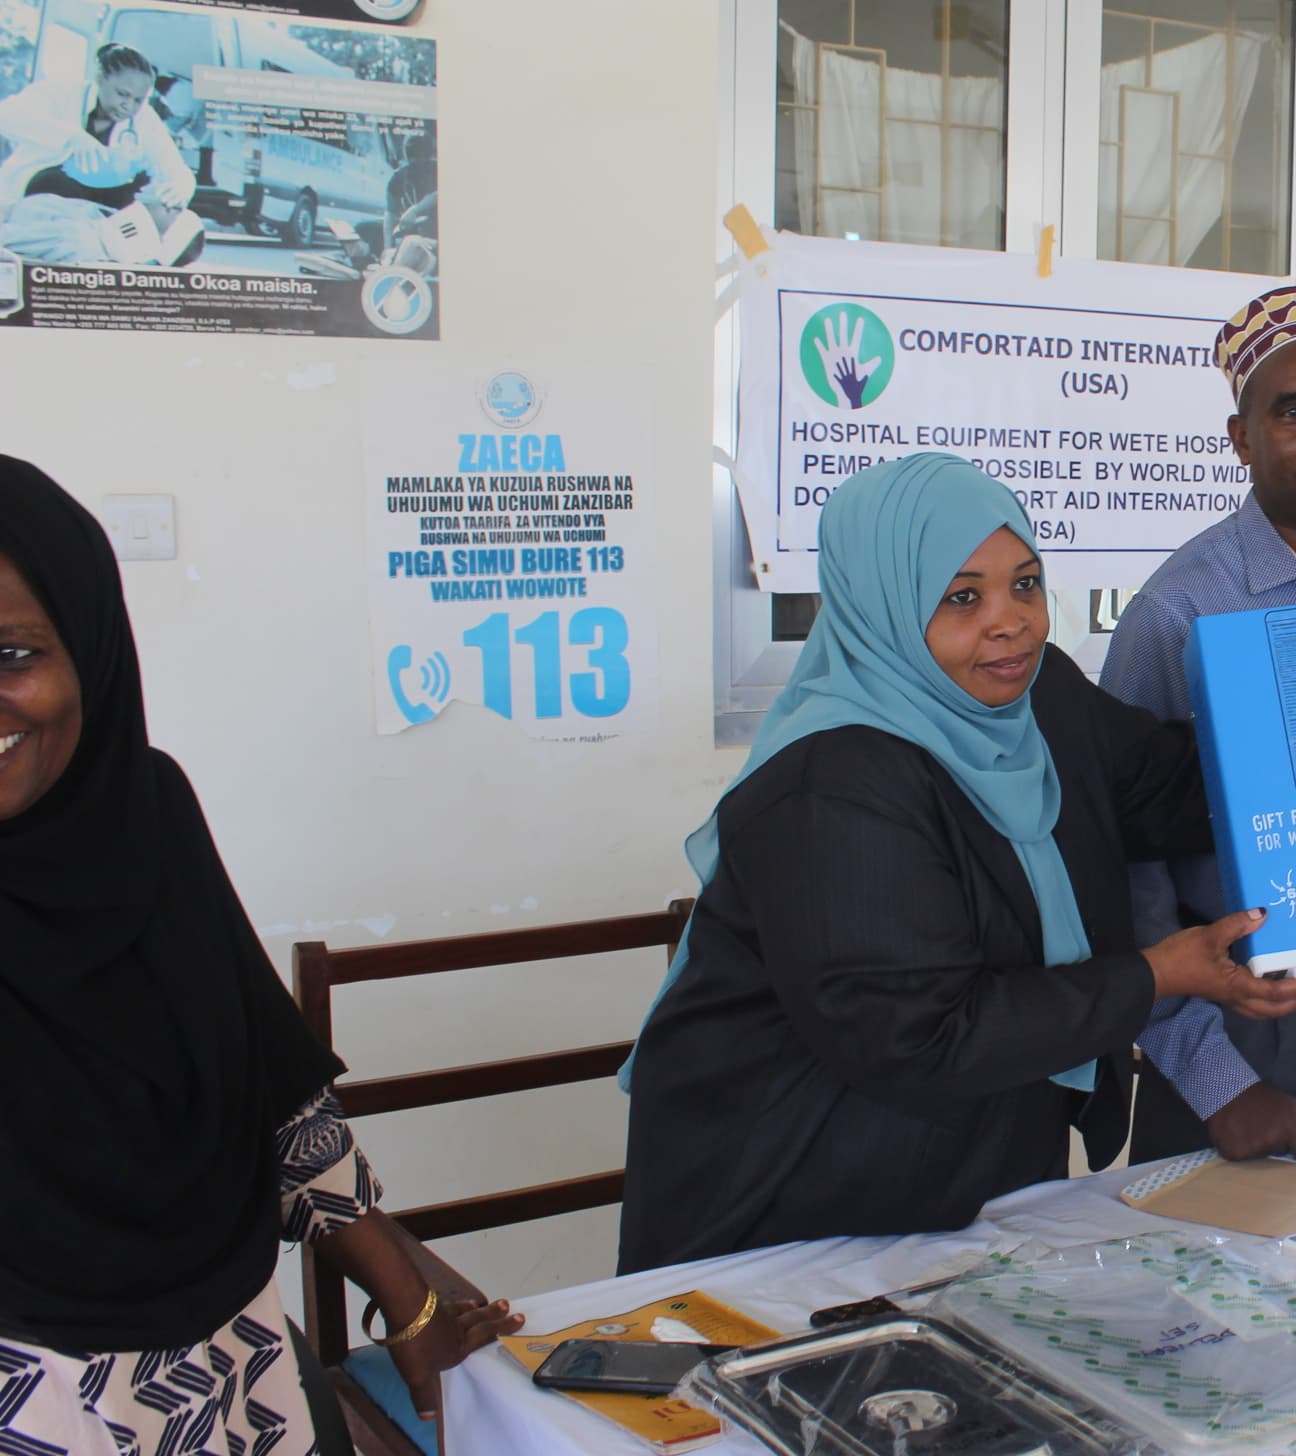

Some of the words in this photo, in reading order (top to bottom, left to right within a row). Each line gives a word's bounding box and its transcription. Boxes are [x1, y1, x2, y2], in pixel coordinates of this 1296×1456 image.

[31, 266, 116, 288] Changia
[120, 271, 185, 289] Damu.
[190, 274, 241, 291] Okoa
[246, 278, 318, 295] maisha.
[899, 328, 1074, 360] COMFORTAID
[1061, 370, 1129, 400] (USA)
[791, 421, 909, 446] HOSPITAL
[916, 425, 1050, 450] EQUIPMENT
[1058, 429, 1103, 450] FOR
[1109, 432, 1168, 453] WETE
[458, 434, 565, 473] ZAECA
[387, 476, 464, 493] MAMLAKA
[468, 476, 486, 493] YA
[490, 475, 543, 493] KUZUIA
[546, 475, 611, 492] RUSHWA
[614, 475, 633, 491] NA
[1096, 462, 1123, 480] BY
[1130, 463, 1205, 482] WORLD
[1212, 465, 1252, 484] WID
[387, 495, 464, 513] UHUJUMU
[467, 495, 494, 512] WA
[499, 495, 559, 512] UCHUMI
[562, 494, 633, 511] ZANZIBAR
[1064, 491, 1100, 510] AID
[420, 516, 461, 530] KUTOA
[463, 515, 511, 530] TAARIFA
[516, 515, 530, 529] ZA
[532, 514, 581, 528] VITENDO
[584, 513, 605, 528] VYA
[420, 531, 470, 545] RUSHWA
[472, 531, 487, 545] NA
[488, 530, 541, 544] UHUJUMU
[543, 530, 561, 543] WA
[563, 529, 606, 543] UCHUMI
[388, 550, 447, 578] PIGA
[452, 549, 515, 576] SIMU
[521, 548, 582, 574] BURE
[586, 546, 624, 573] 113
[431, 580, 502, 602] WAKATI
[506, 577, 587, 600] WOWOTE
[463, 606, 631, 720] 113
[1252, 812, 1285, 832] GIFT
[1256, 832, 1282, 853] FOR
